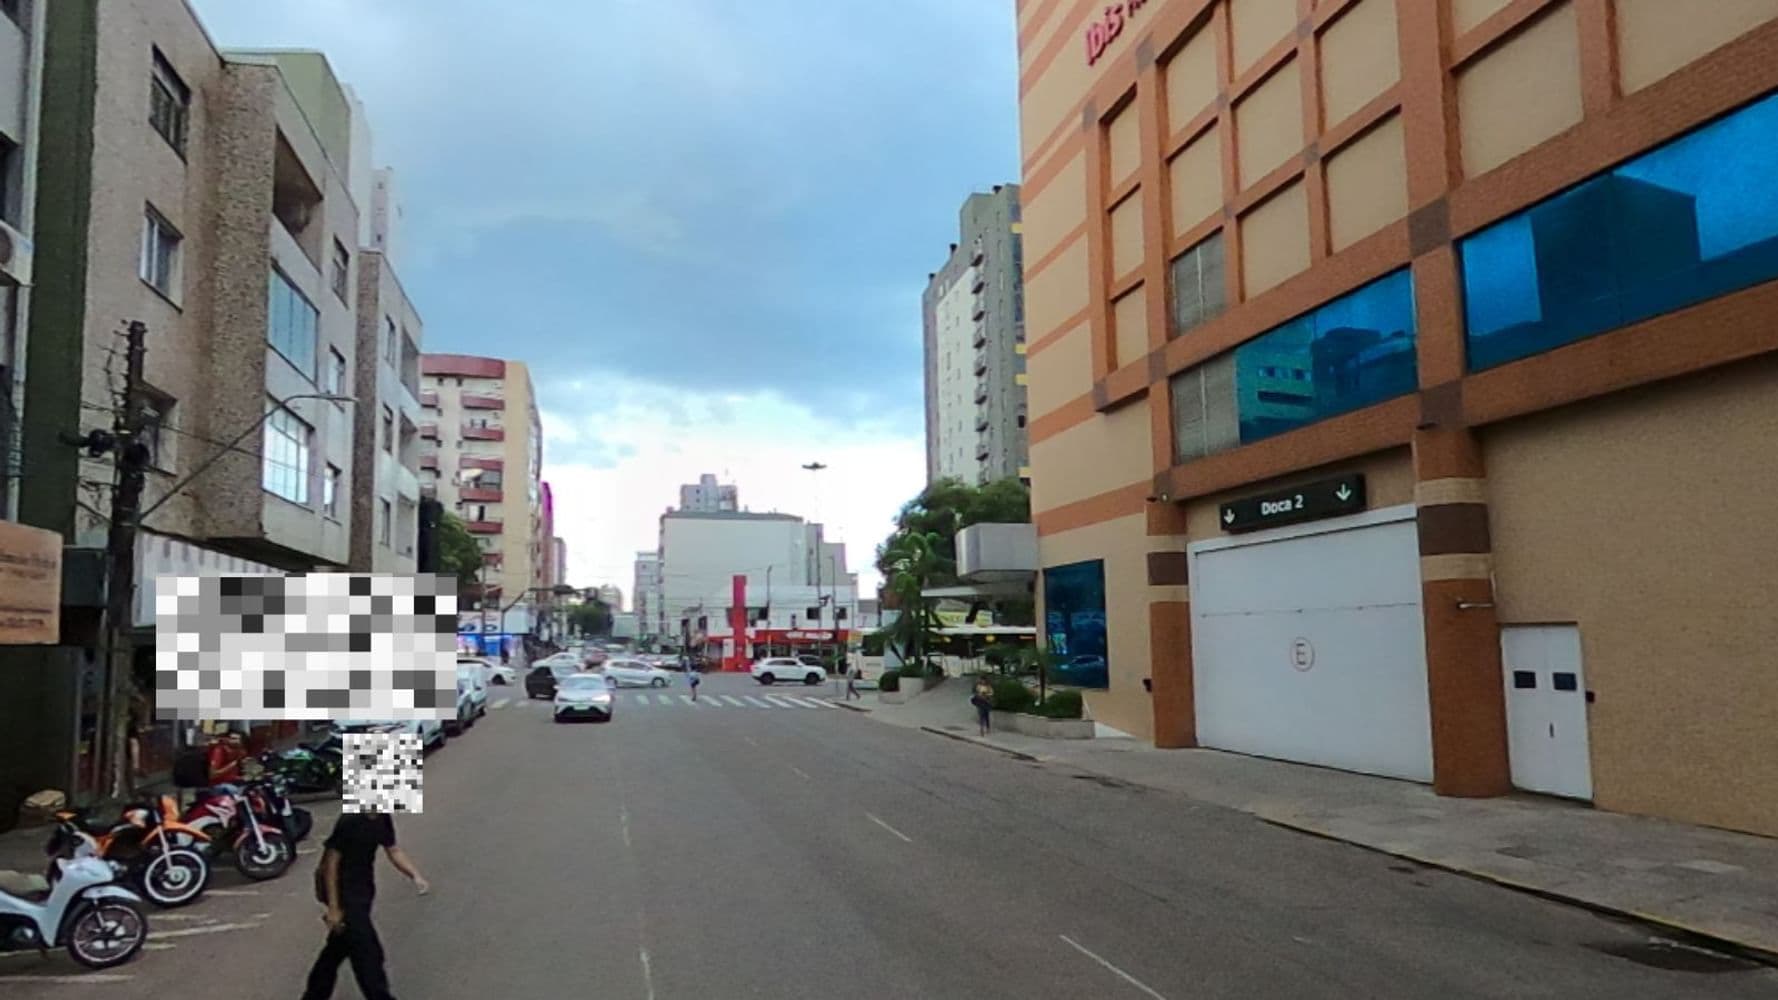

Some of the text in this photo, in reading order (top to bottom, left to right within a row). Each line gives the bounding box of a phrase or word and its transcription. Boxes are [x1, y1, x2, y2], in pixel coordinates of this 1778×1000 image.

[1261, 494, 1304, 516] Doca 2
[1296, 642, 1306, 666] E
